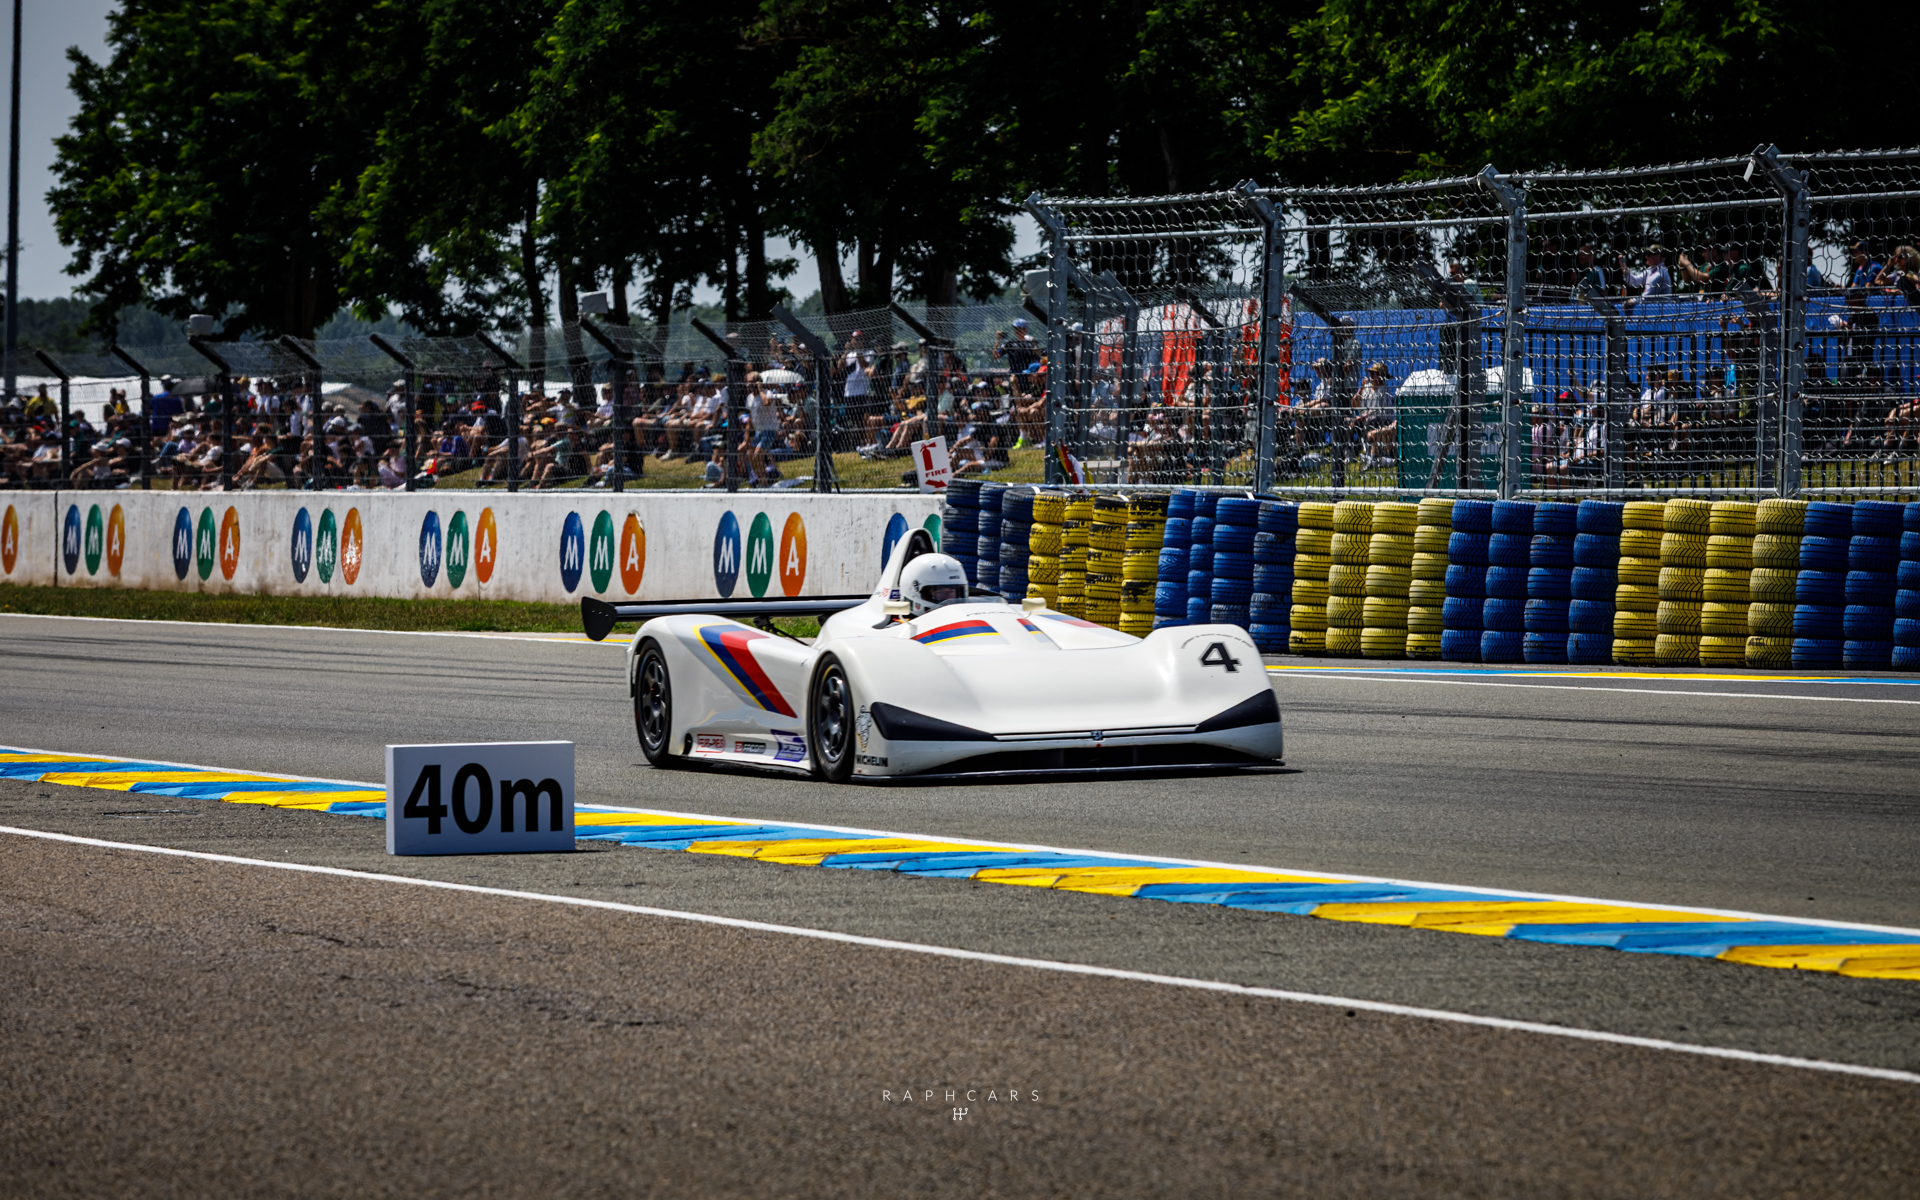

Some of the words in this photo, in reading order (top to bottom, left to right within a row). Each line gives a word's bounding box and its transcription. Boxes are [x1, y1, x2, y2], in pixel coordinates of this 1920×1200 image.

[924, 467, 948, 478] FIRE
[66, 523, 120, 556] MMA
[176, 526, 234, 561] MMA
[295, 528, 357, 565] MMA
[423, 528, 491, 565] MMA
[564, 533, 639, 571] MMA
[718, 536, 800, 576] MMA
[1200, 641, 1241, 673] 4
[855, 754, 888, 767] MICHELIN
[403, 762, 564, 835] 40m
